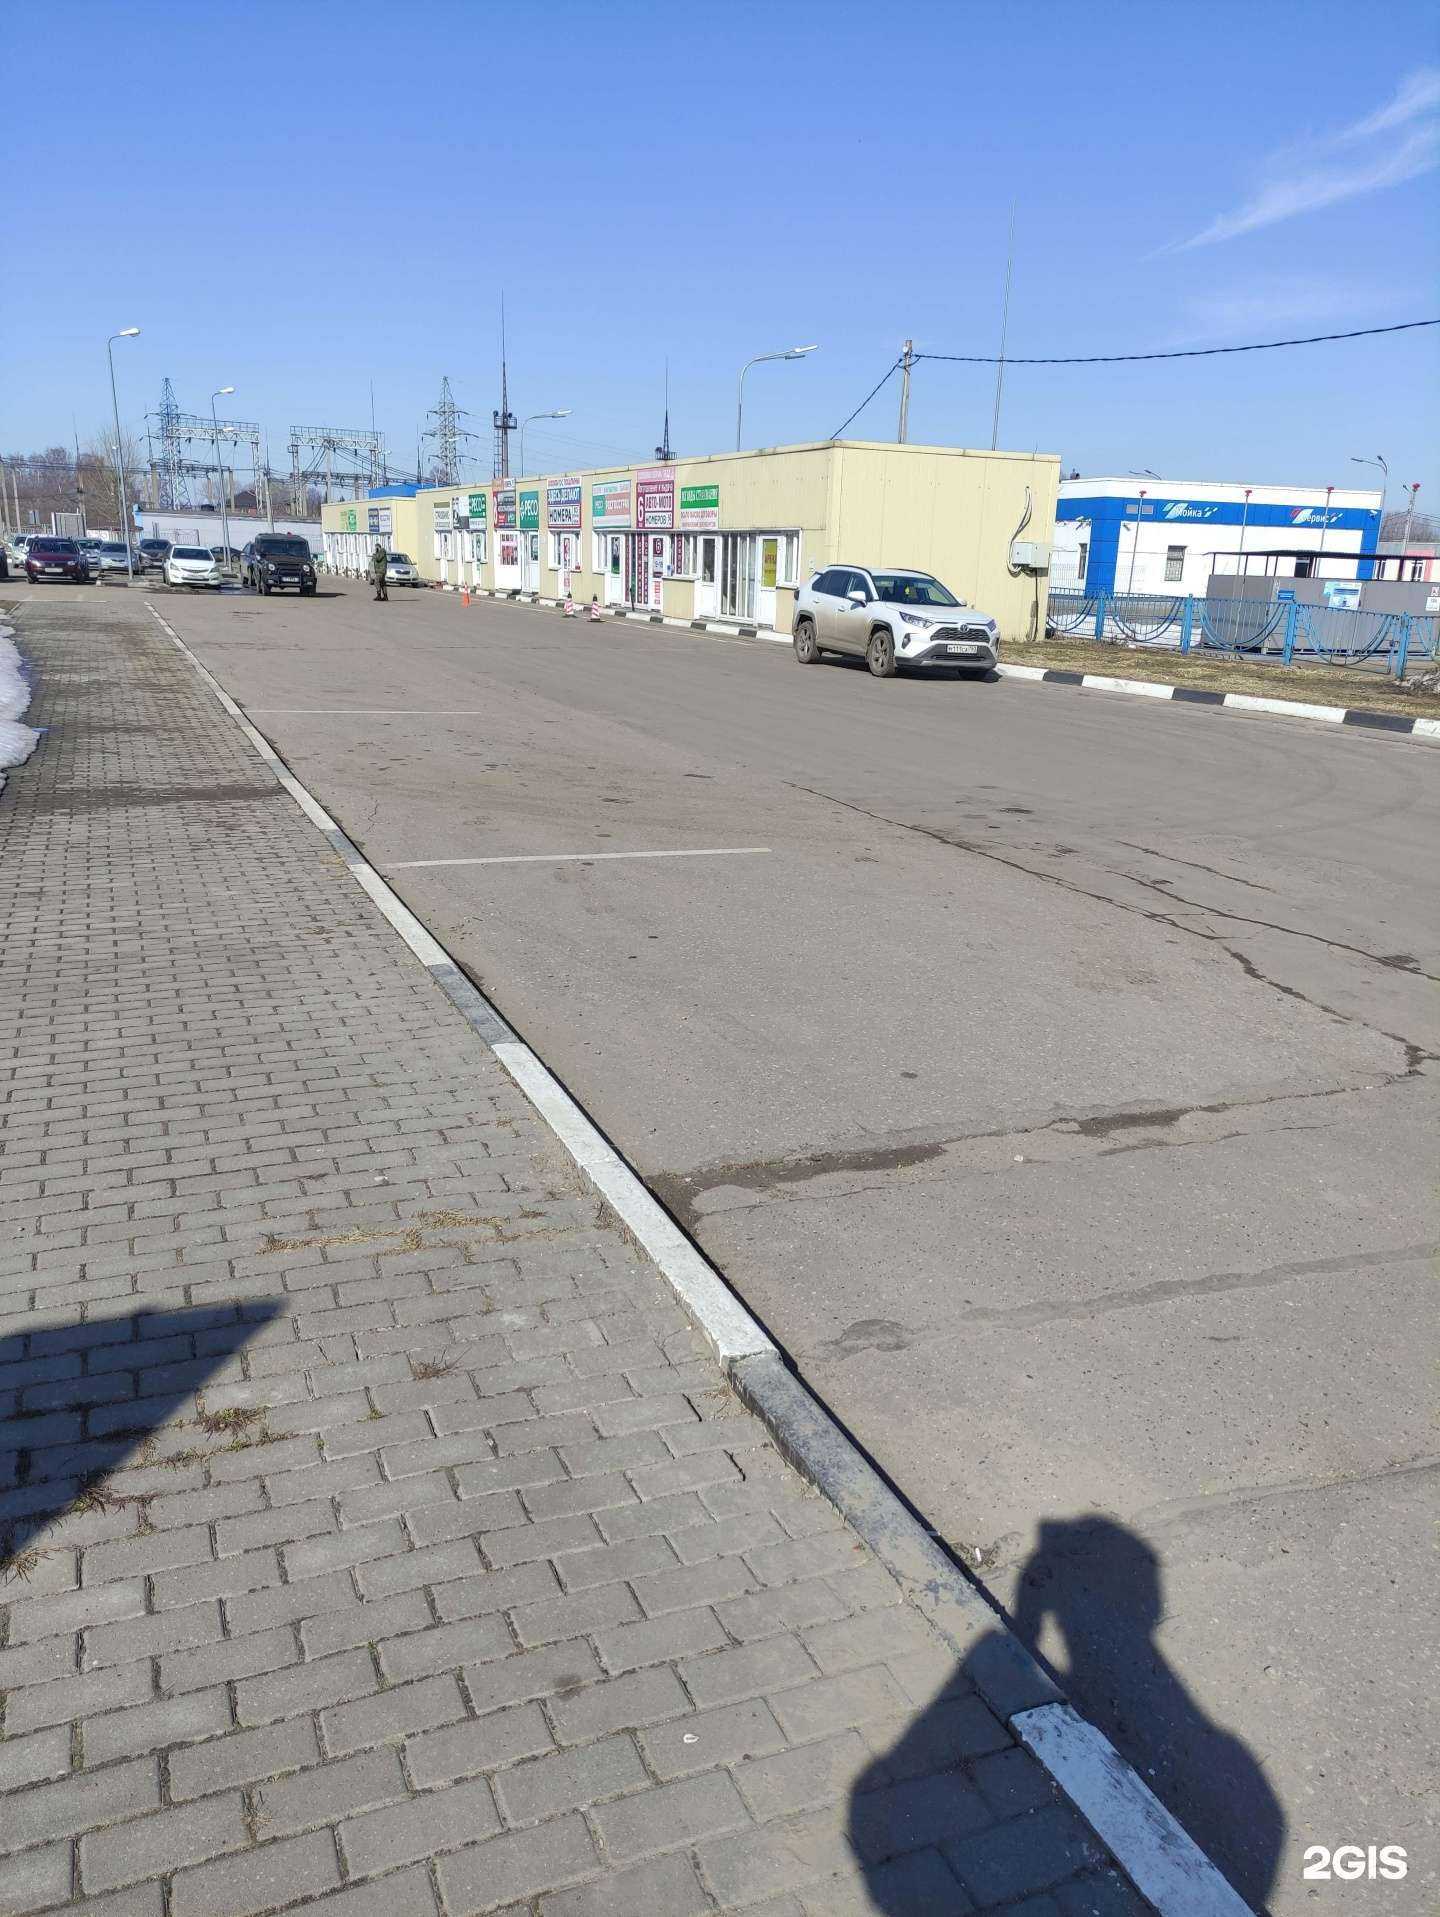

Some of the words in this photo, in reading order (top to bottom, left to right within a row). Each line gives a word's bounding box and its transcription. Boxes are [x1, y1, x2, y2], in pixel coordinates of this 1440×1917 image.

[524, 499, 538, 516] РЕСО
[550, 508, 571, 523] НОМЕРА
[646, 515, 666, 524] НОМЕРОВ
